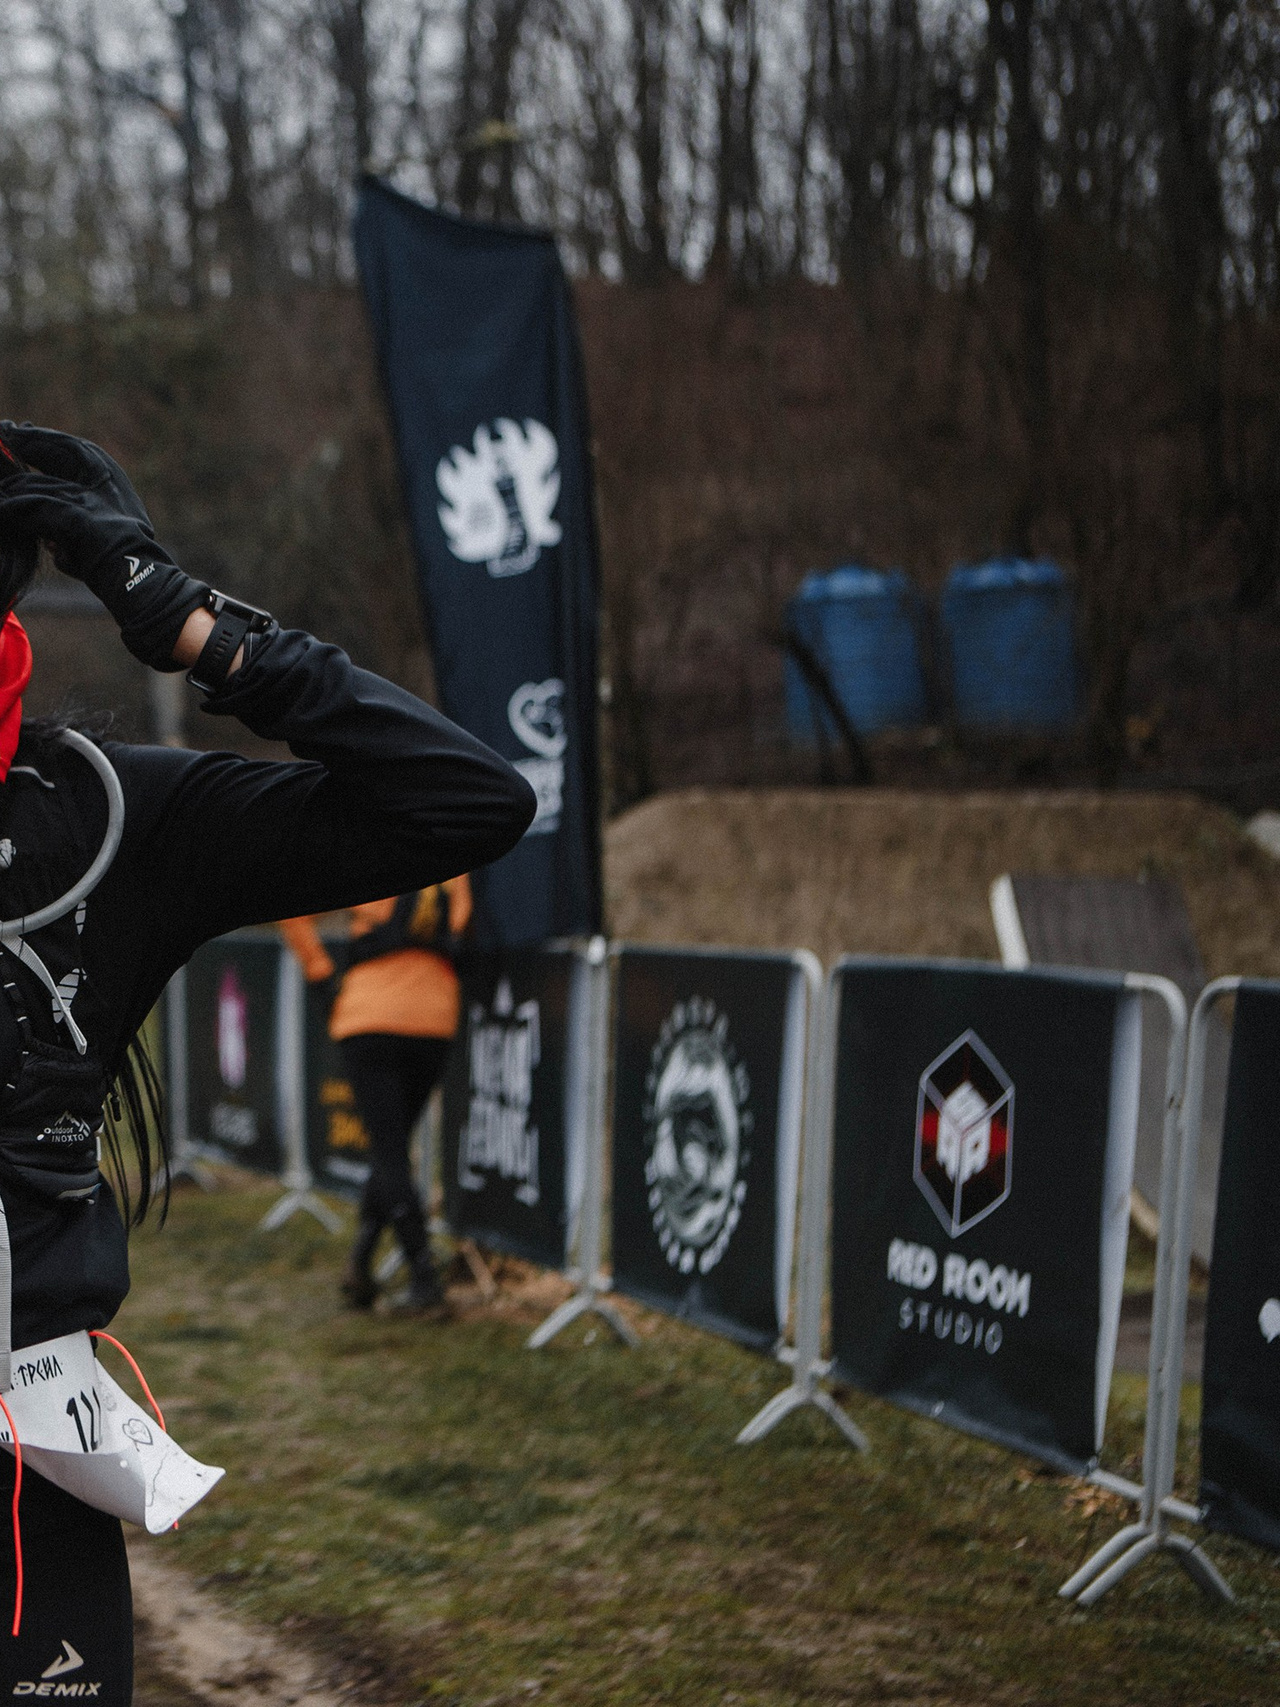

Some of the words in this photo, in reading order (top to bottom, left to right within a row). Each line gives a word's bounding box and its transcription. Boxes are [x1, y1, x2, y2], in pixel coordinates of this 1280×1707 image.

[125, 562, 156, 592] DEMIX
[43, 1126, 74, 1135] Outdoor
[51, 1133, 85, 1143] INOXTO
[887, 1237, 938, 1291] RED
[942, 1252, 1032, 1320] ROOM
[898, 1296, 1004, 1356] STUDIO
[12, 1680, 102, 1697] DEMIX
